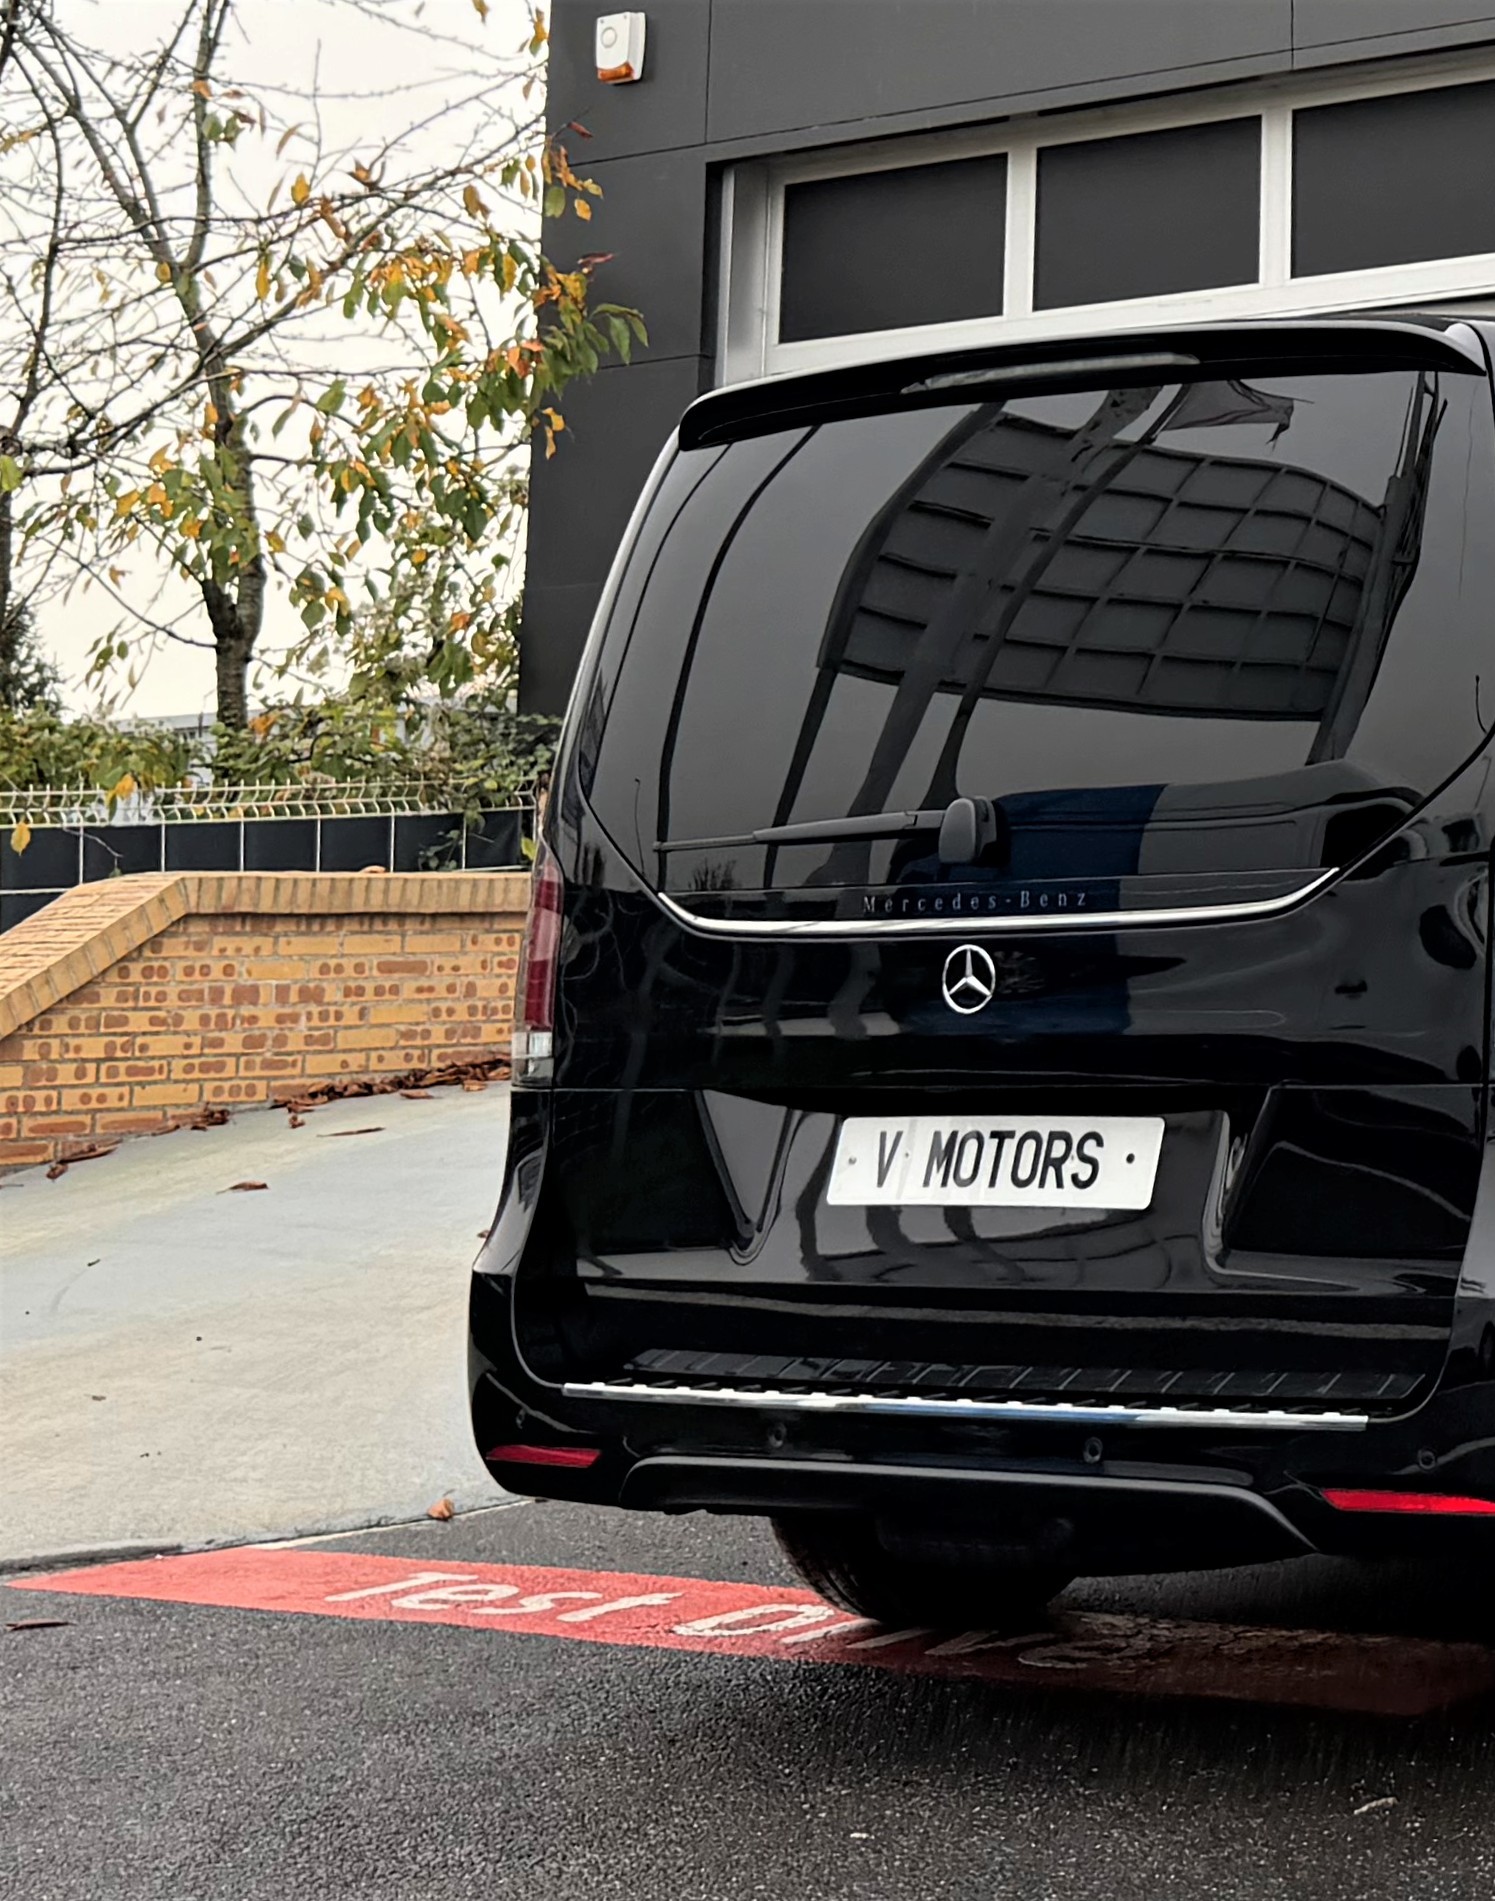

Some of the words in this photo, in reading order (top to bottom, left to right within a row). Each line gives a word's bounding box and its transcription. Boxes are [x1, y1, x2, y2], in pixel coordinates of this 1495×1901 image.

[863, 890, 1087, 913] Mercedes-Benz
[876, 1130, 904, 1188] V
[922, 1129, 1105, 1190] MOTORS
[323, 1571, 685, 1622] Test
